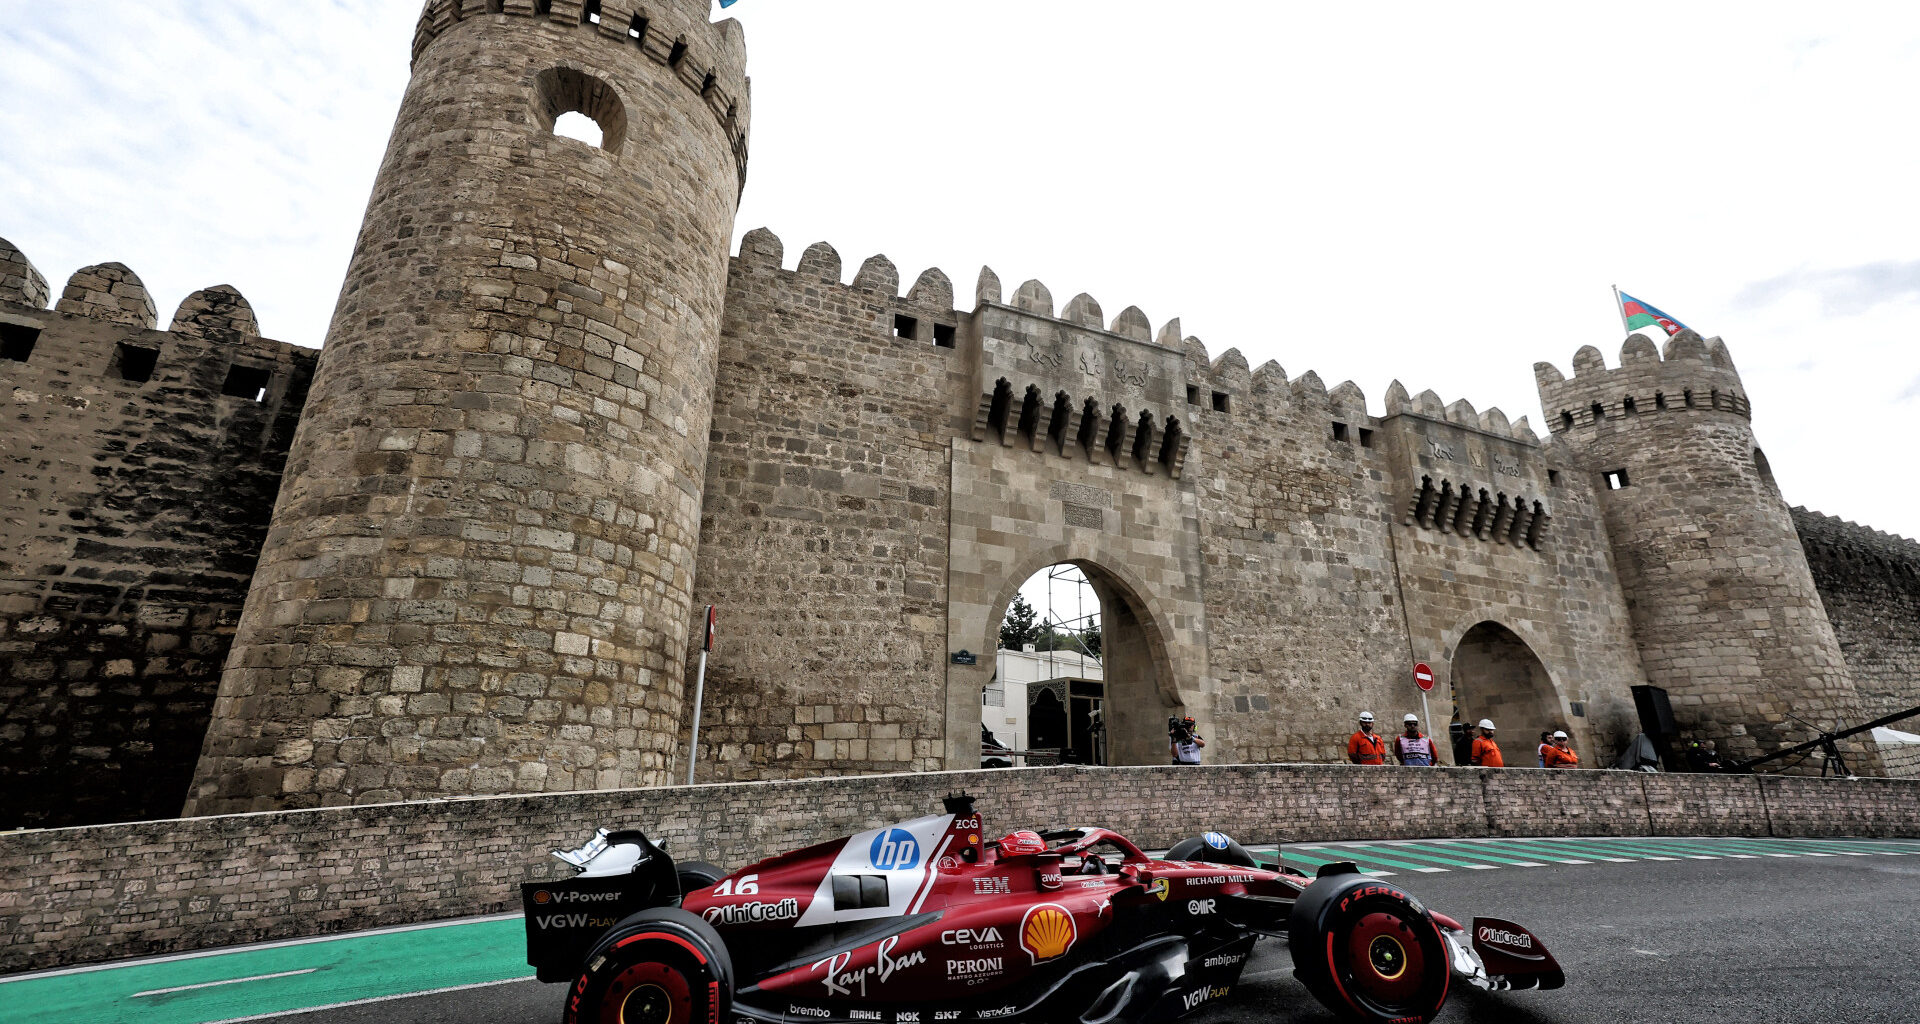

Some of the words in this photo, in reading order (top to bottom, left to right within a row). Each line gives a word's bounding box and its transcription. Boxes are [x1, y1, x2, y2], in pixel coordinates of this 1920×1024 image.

[955, 819, 979, 829] ZCG
[875, 828, 916, 870] hp
[712, 873, 759, 897] 16
[972, 876, 1011, 894] IBM
[1041, 873, 1062, 883] aws
[1186, 875, 1226, 886] RICHARD
[1228, 874, 1255, 883] MILLE
[552, 891, 622, 903] V-Power
[1340, 897, 1349, 912] P
[1352, 886, 1405, 901] ZERO
[723, 899, 797, 924] UniCredit
[536, 913, 588, 930] VGW
[1489, 928, 1531, 949] UniCredit
[969, 942, 1005, 951] LOGISTICS
[946, 957, 1004, 975] PERONI
[1204, 953, 1241, 967] ambipar
[1183, 985, 1212, 1011] VGW
[790, 1004, 831, 1017] brembo
[850, 1010, 882, 1020] MAHLE
[896, 1011, 920, 1021] NGK
[934, 1011, 962, 1020] SKF
